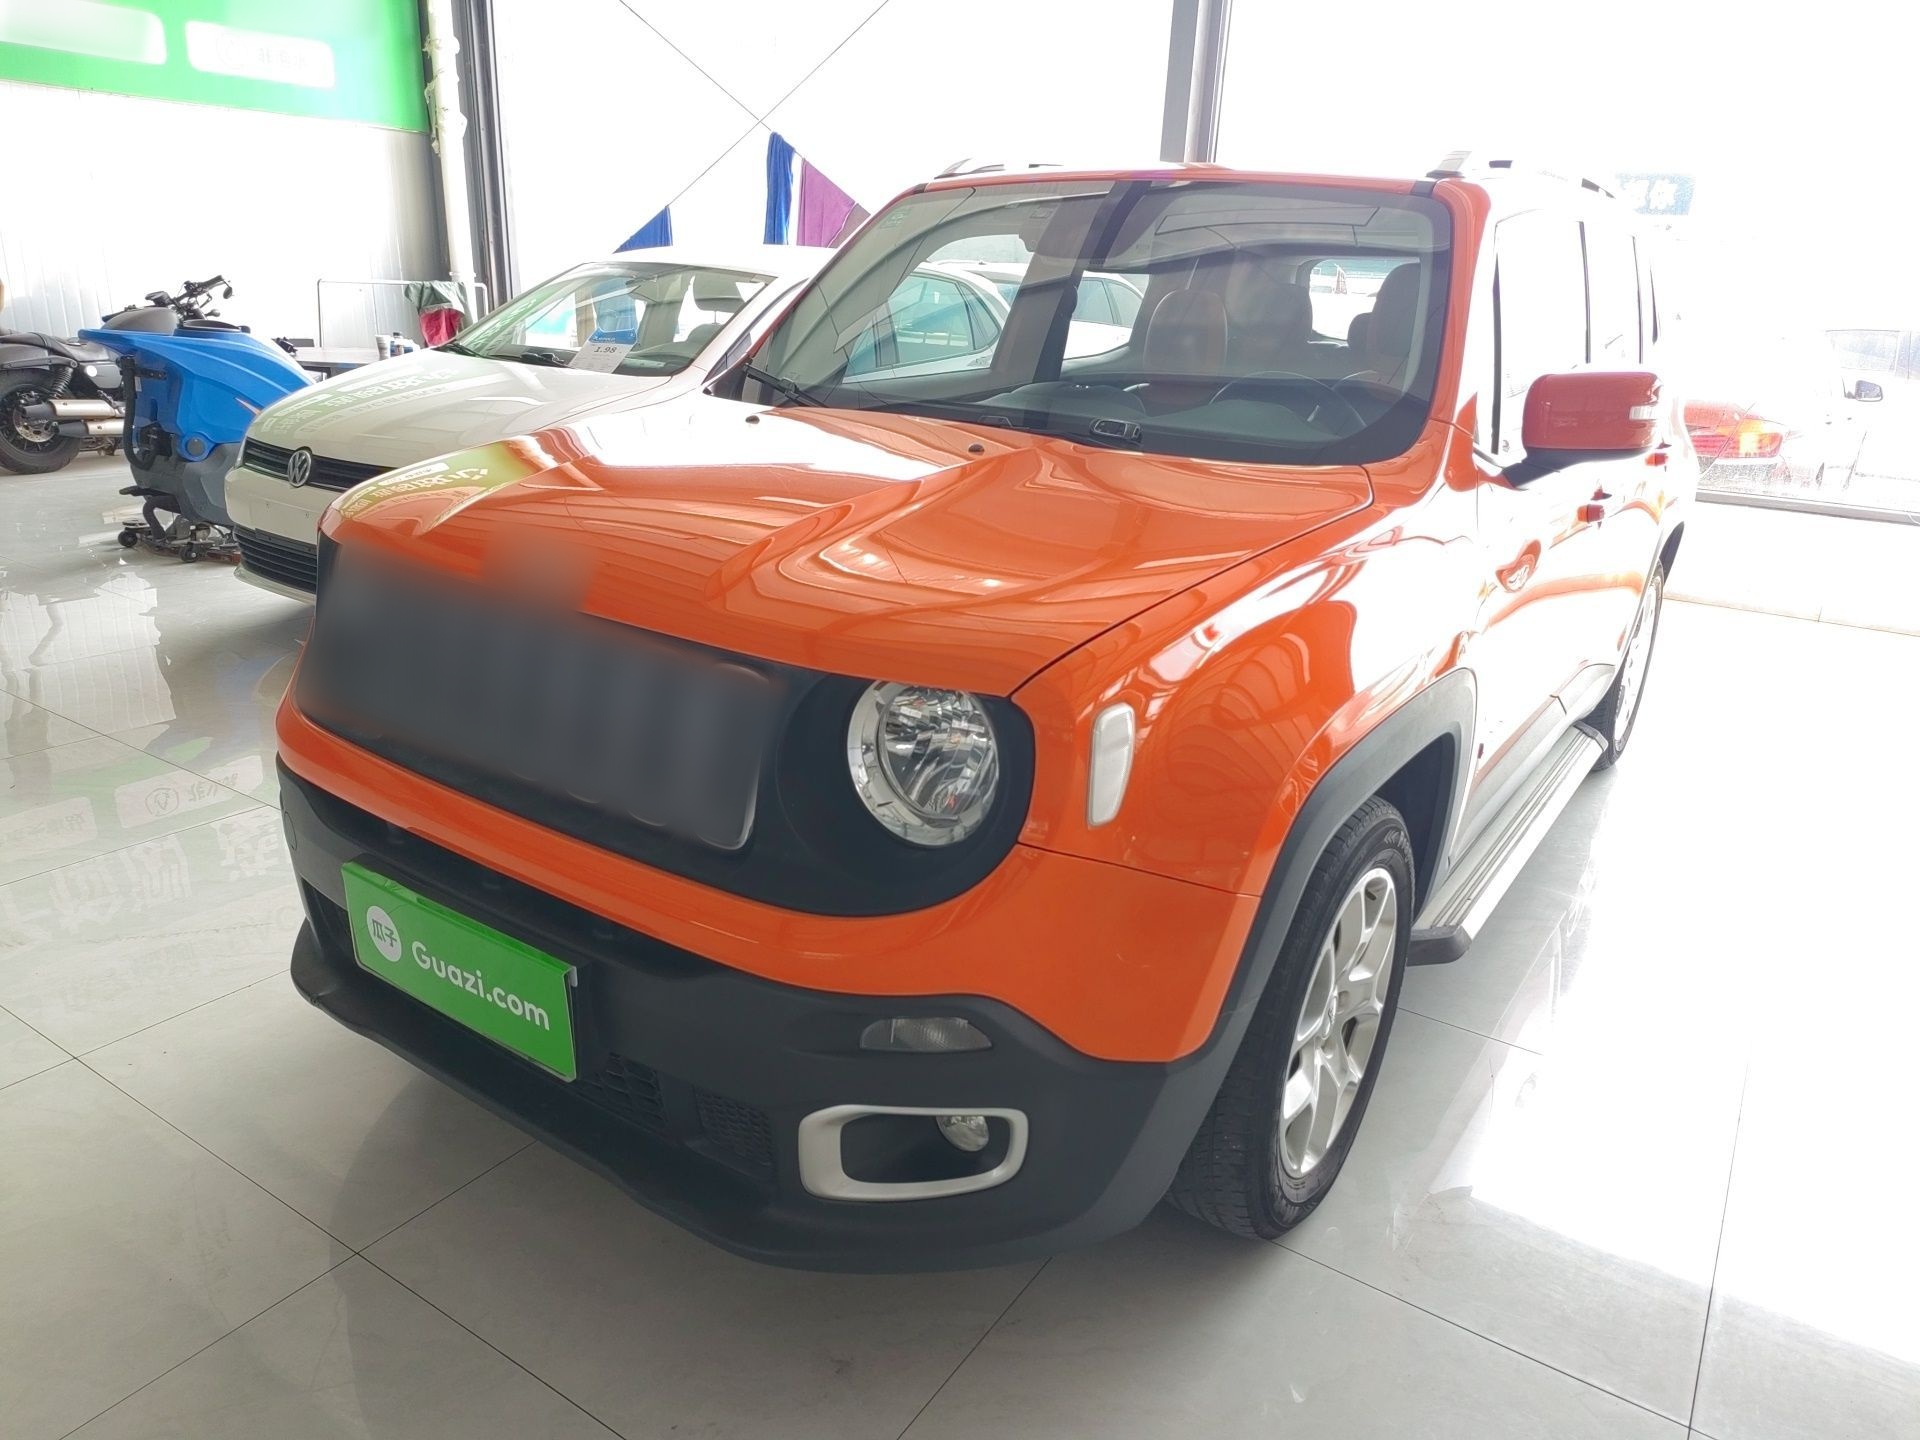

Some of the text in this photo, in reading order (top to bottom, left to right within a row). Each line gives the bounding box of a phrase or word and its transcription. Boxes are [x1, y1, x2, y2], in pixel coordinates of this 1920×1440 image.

[593, 346, 618, 354] 1.98
[371, 918, 398, 948] 瓜子
[411, 940, 550, 1031] Guazi.com
